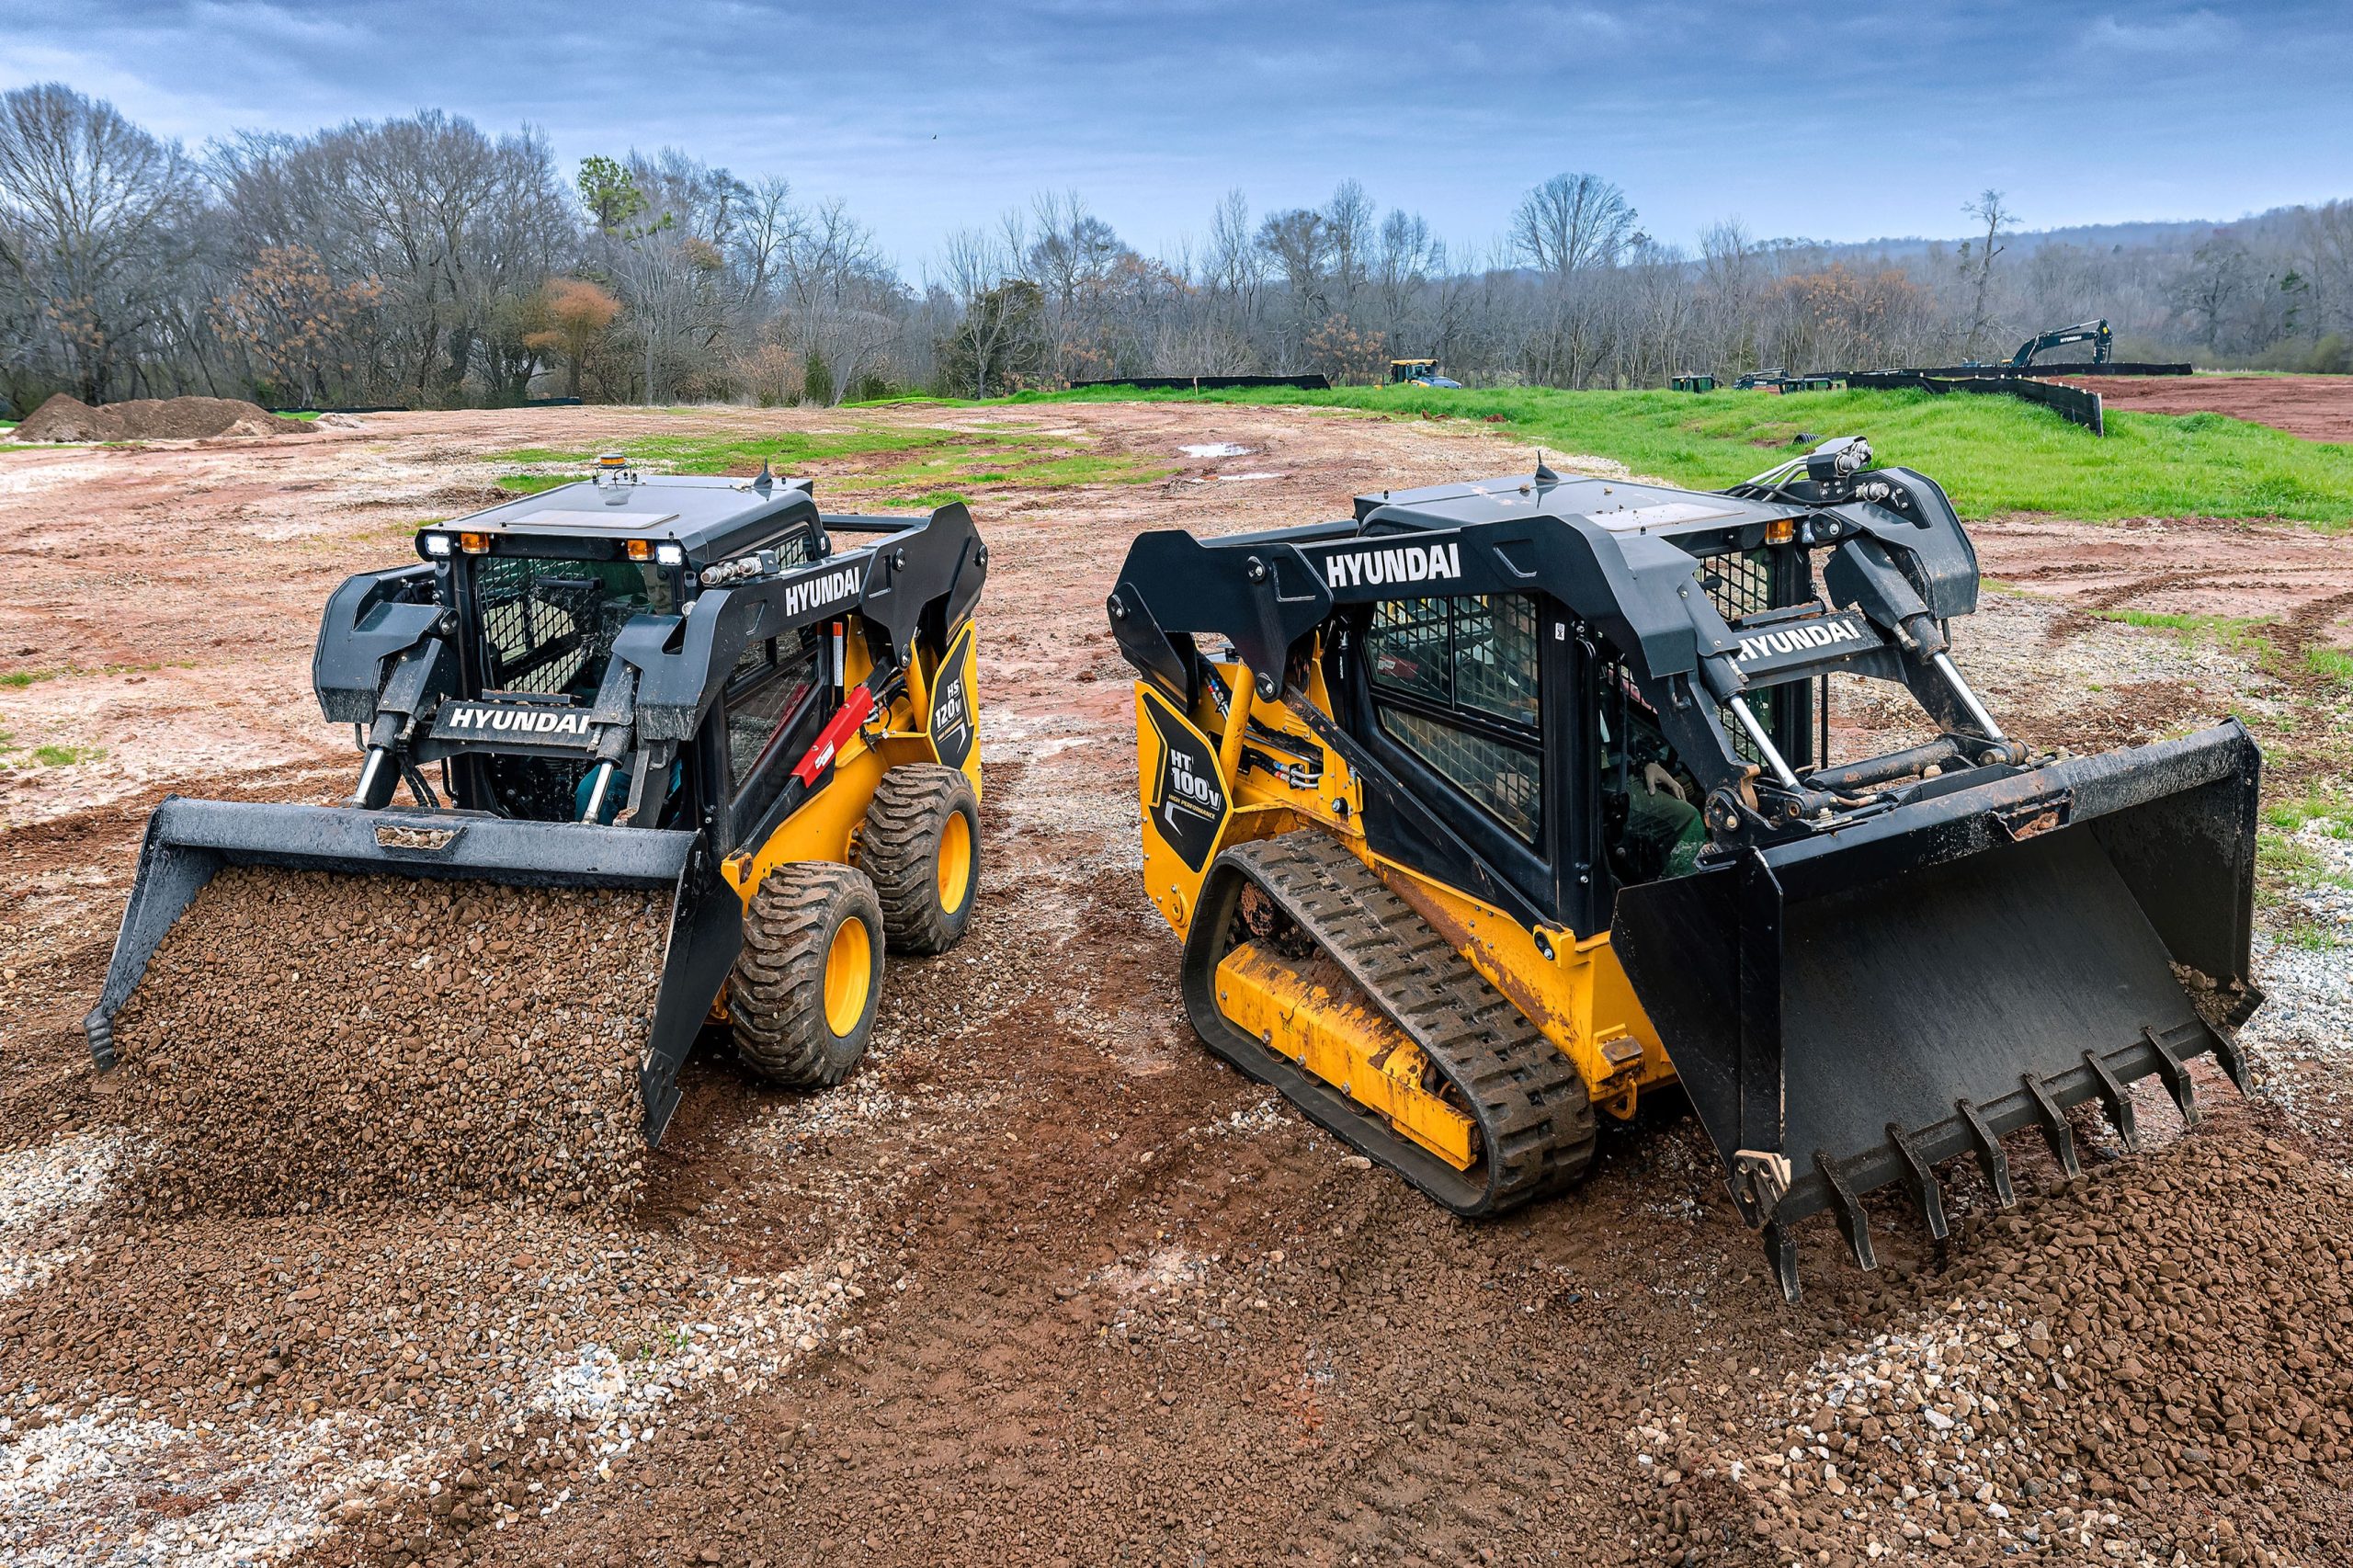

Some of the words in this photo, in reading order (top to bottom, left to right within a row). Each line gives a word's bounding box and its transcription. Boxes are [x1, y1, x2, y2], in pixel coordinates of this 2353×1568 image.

[1325, 542, 1461, 588] HYUNDAI
[785, 566, 860, 617] HYUNDAI
[1736, 619, 1862, 662] HYUNDAI
[947, 678, 961, 699] HS
[449, 708, 591, 734] HYUNDAI
[1170, 749, 1193, 772] HT
